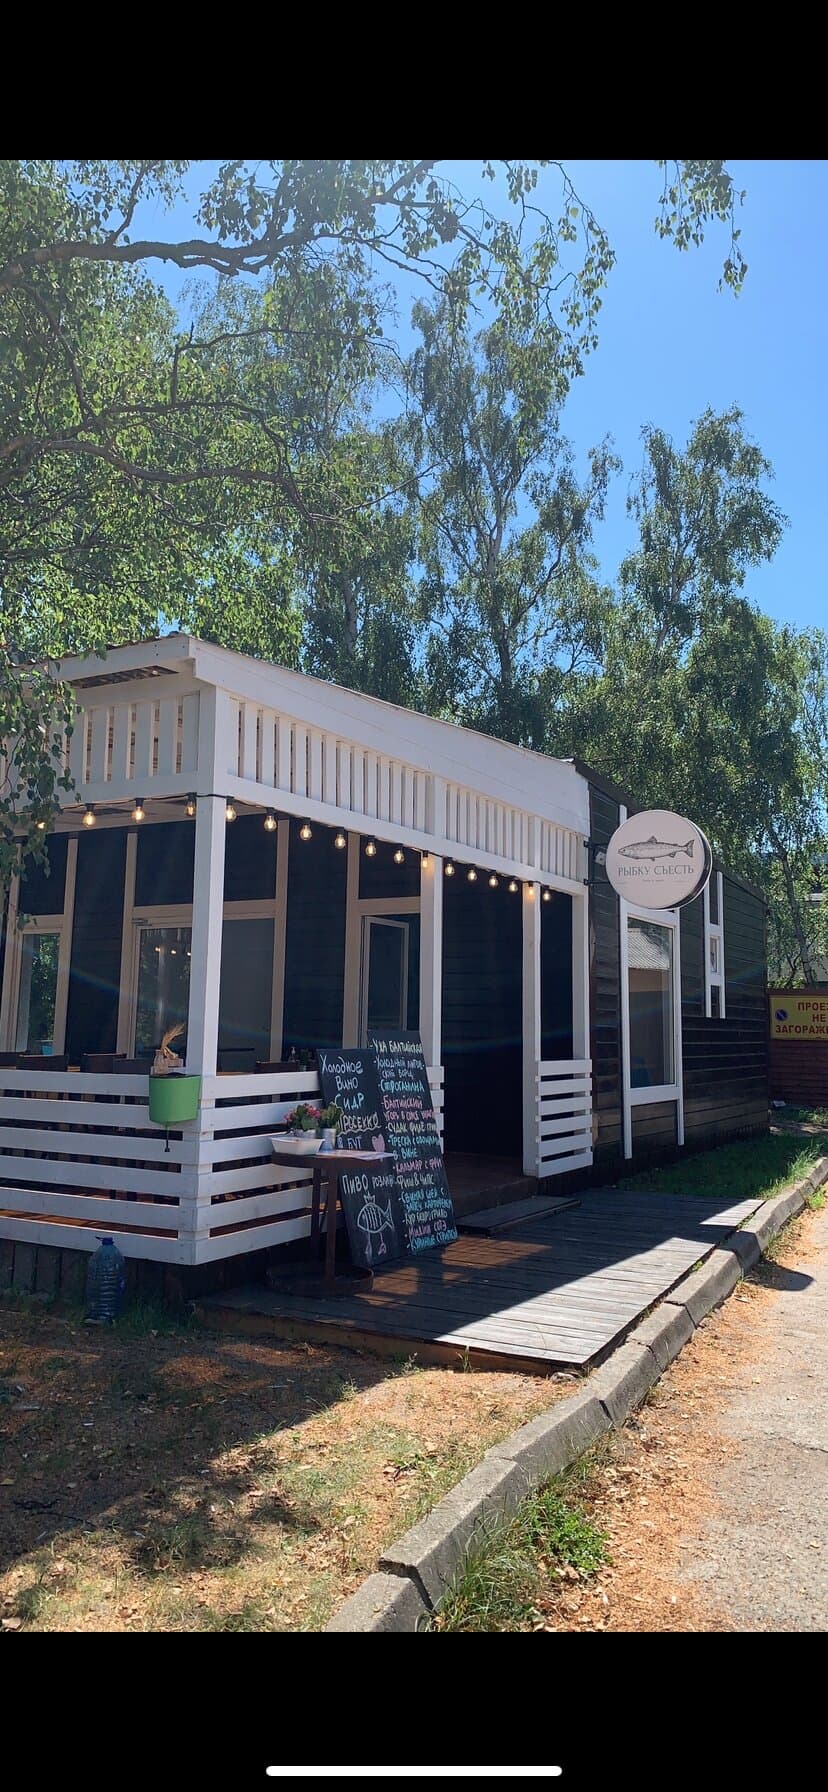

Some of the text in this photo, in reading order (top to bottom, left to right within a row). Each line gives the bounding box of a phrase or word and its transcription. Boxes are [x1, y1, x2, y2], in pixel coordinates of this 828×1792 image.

[618, 864, 694, 876] РЫБКУ СЪЕСТЬ
[813, 1014, 826, 1022] НЕ
